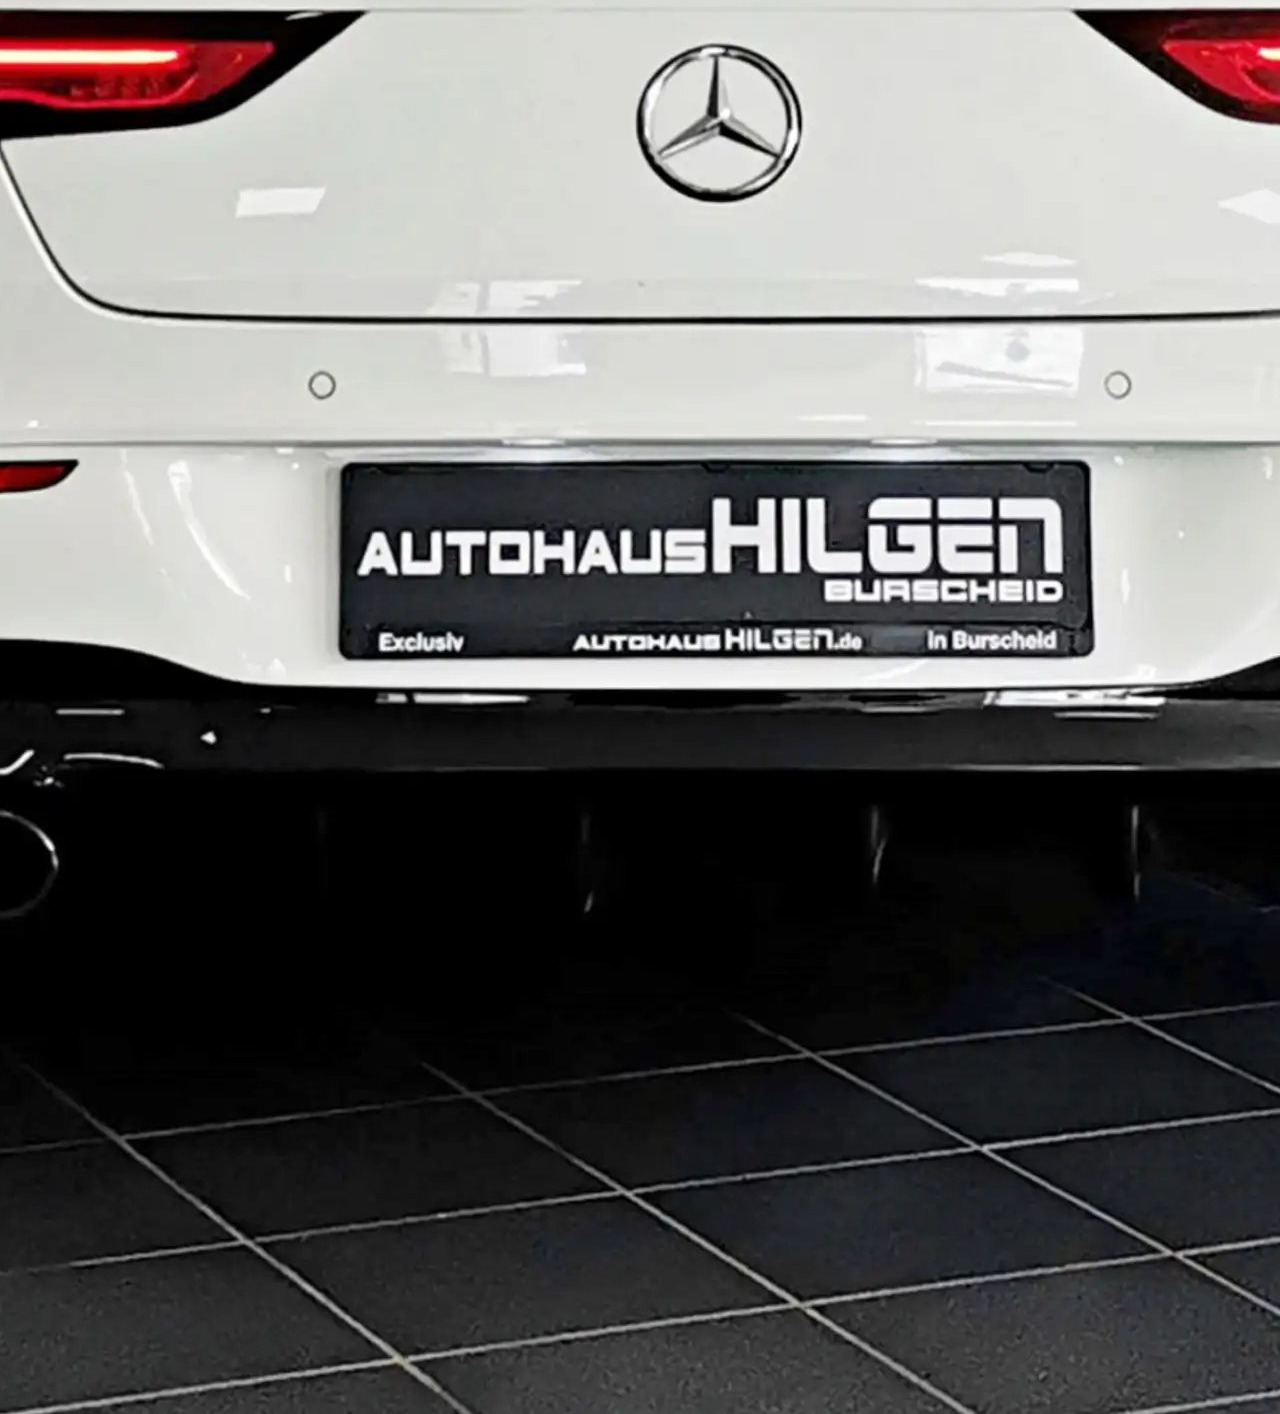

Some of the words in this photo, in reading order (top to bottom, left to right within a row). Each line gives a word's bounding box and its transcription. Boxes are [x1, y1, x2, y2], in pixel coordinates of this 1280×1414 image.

[823, 578, 1064, 603] BURSCHEID
[378, 631, 464, 652] Exclusiv
[951, 629, 1058, 651] Burscheid
